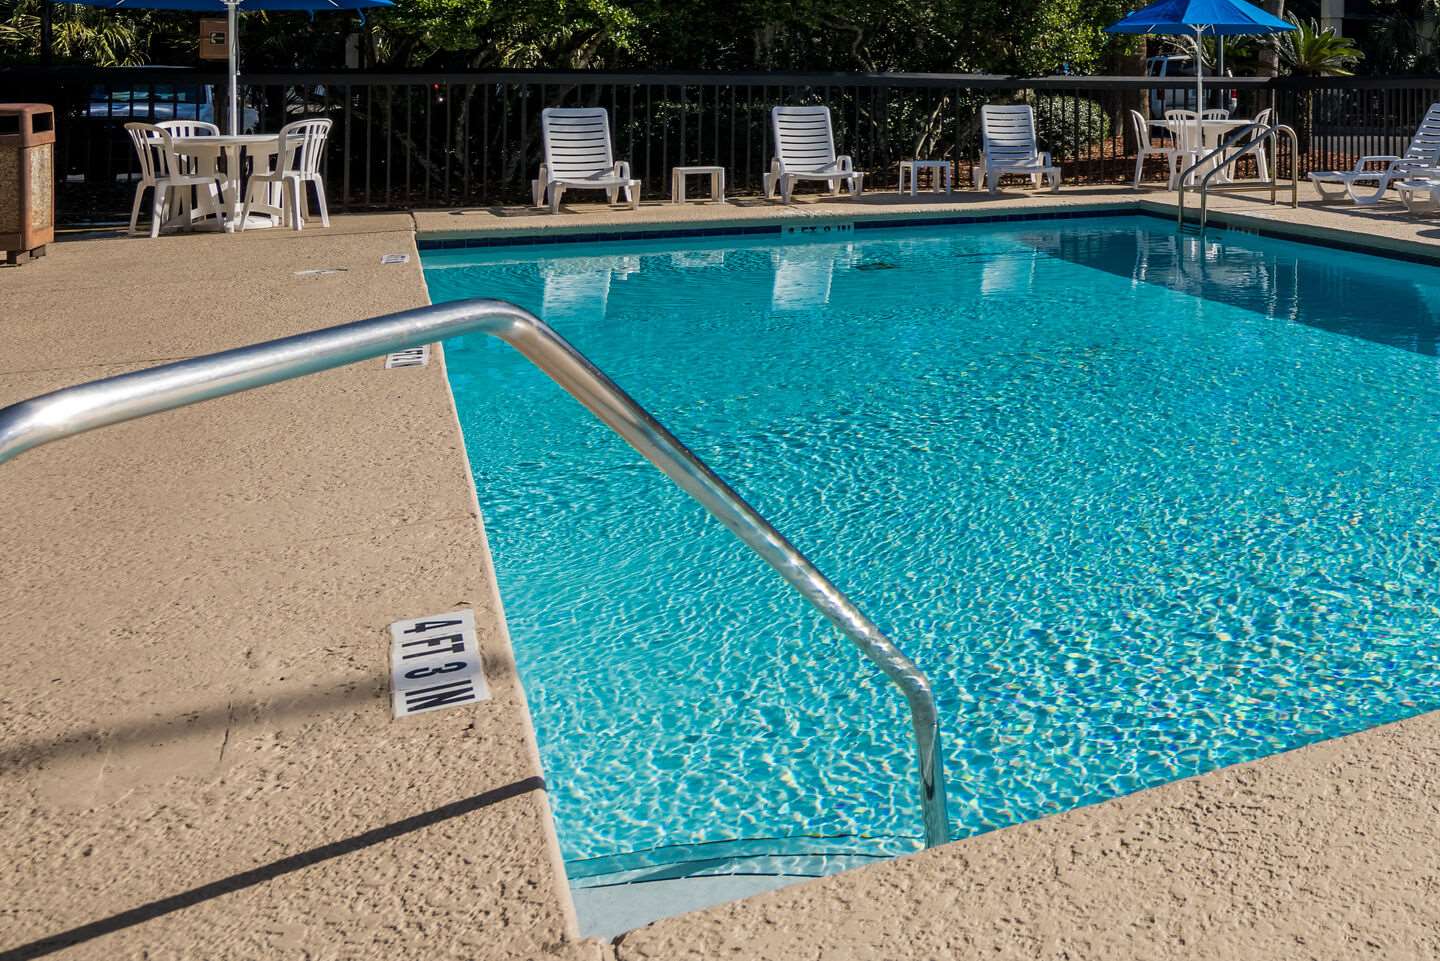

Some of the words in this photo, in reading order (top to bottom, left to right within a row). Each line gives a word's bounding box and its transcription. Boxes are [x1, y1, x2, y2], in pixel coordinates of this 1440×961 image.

[403, 620, 463, 634] 4
[402, 633, 465, 660] FT
[404, 661, 468, 679] 3
[405, 679, 476, 712] IN
